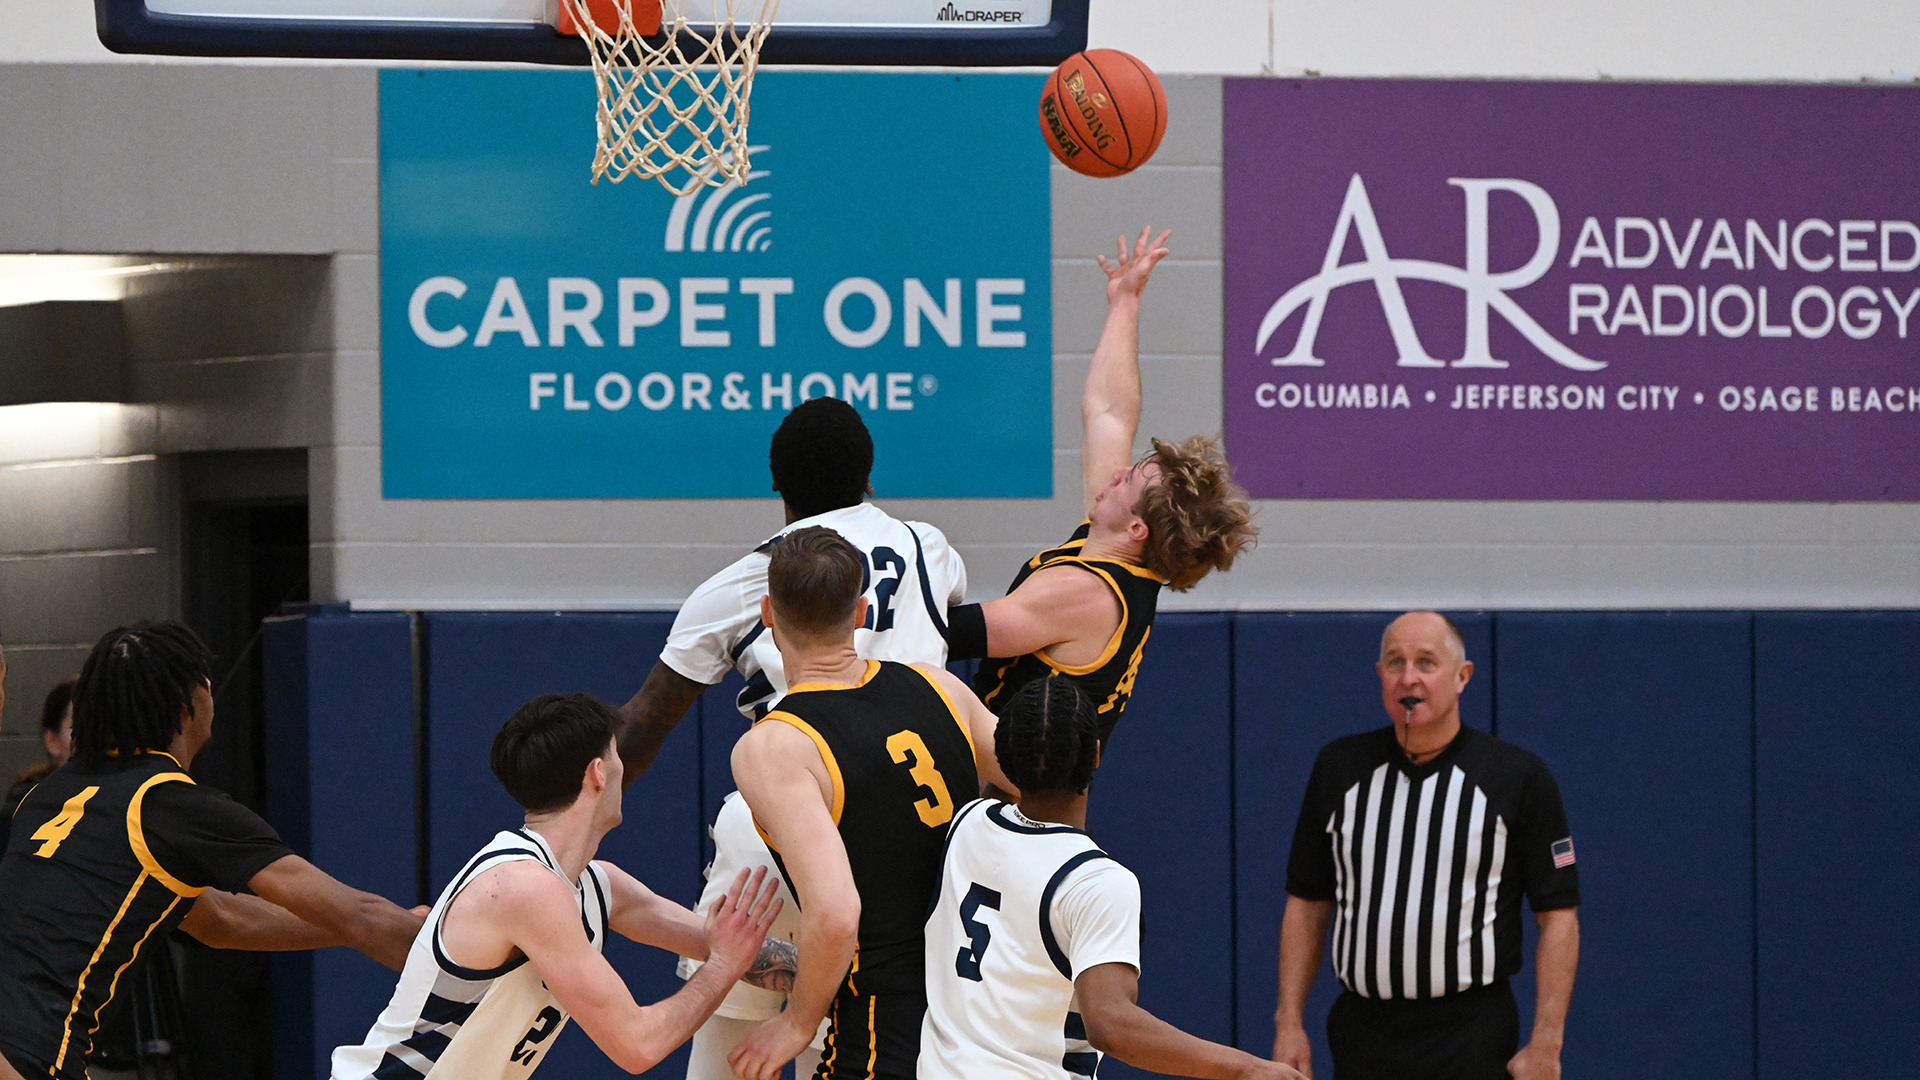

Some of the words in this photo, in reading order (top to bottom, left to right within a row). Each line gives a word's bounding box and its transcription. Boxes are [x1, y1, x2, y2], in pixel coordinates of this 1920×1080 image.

[965, 10, 1022, 23] DRAPER
[1062, 68, 1116, 150] SPALDING
[1256, 173, 1608, 370] AR
[1569, 217, 1920, 272] ADVANCED
[408, 276, 794, 348] CARPET
[824, 277, 1027, 349] ONE
[1569, 284, 1920, 340] RADIOLOGY
[1255, 382, 1411, 409] COLUMBIA
[1451, 384, 1605, 410] JEFFERSON
[1616, 385, 1679, 411] CITY
[1719, 386, 1818, 412] OSAGE
[885, 729, 954, 828] 3
[29, 785, 100, 859] 4
[955, 882, 1002, 983] 5
